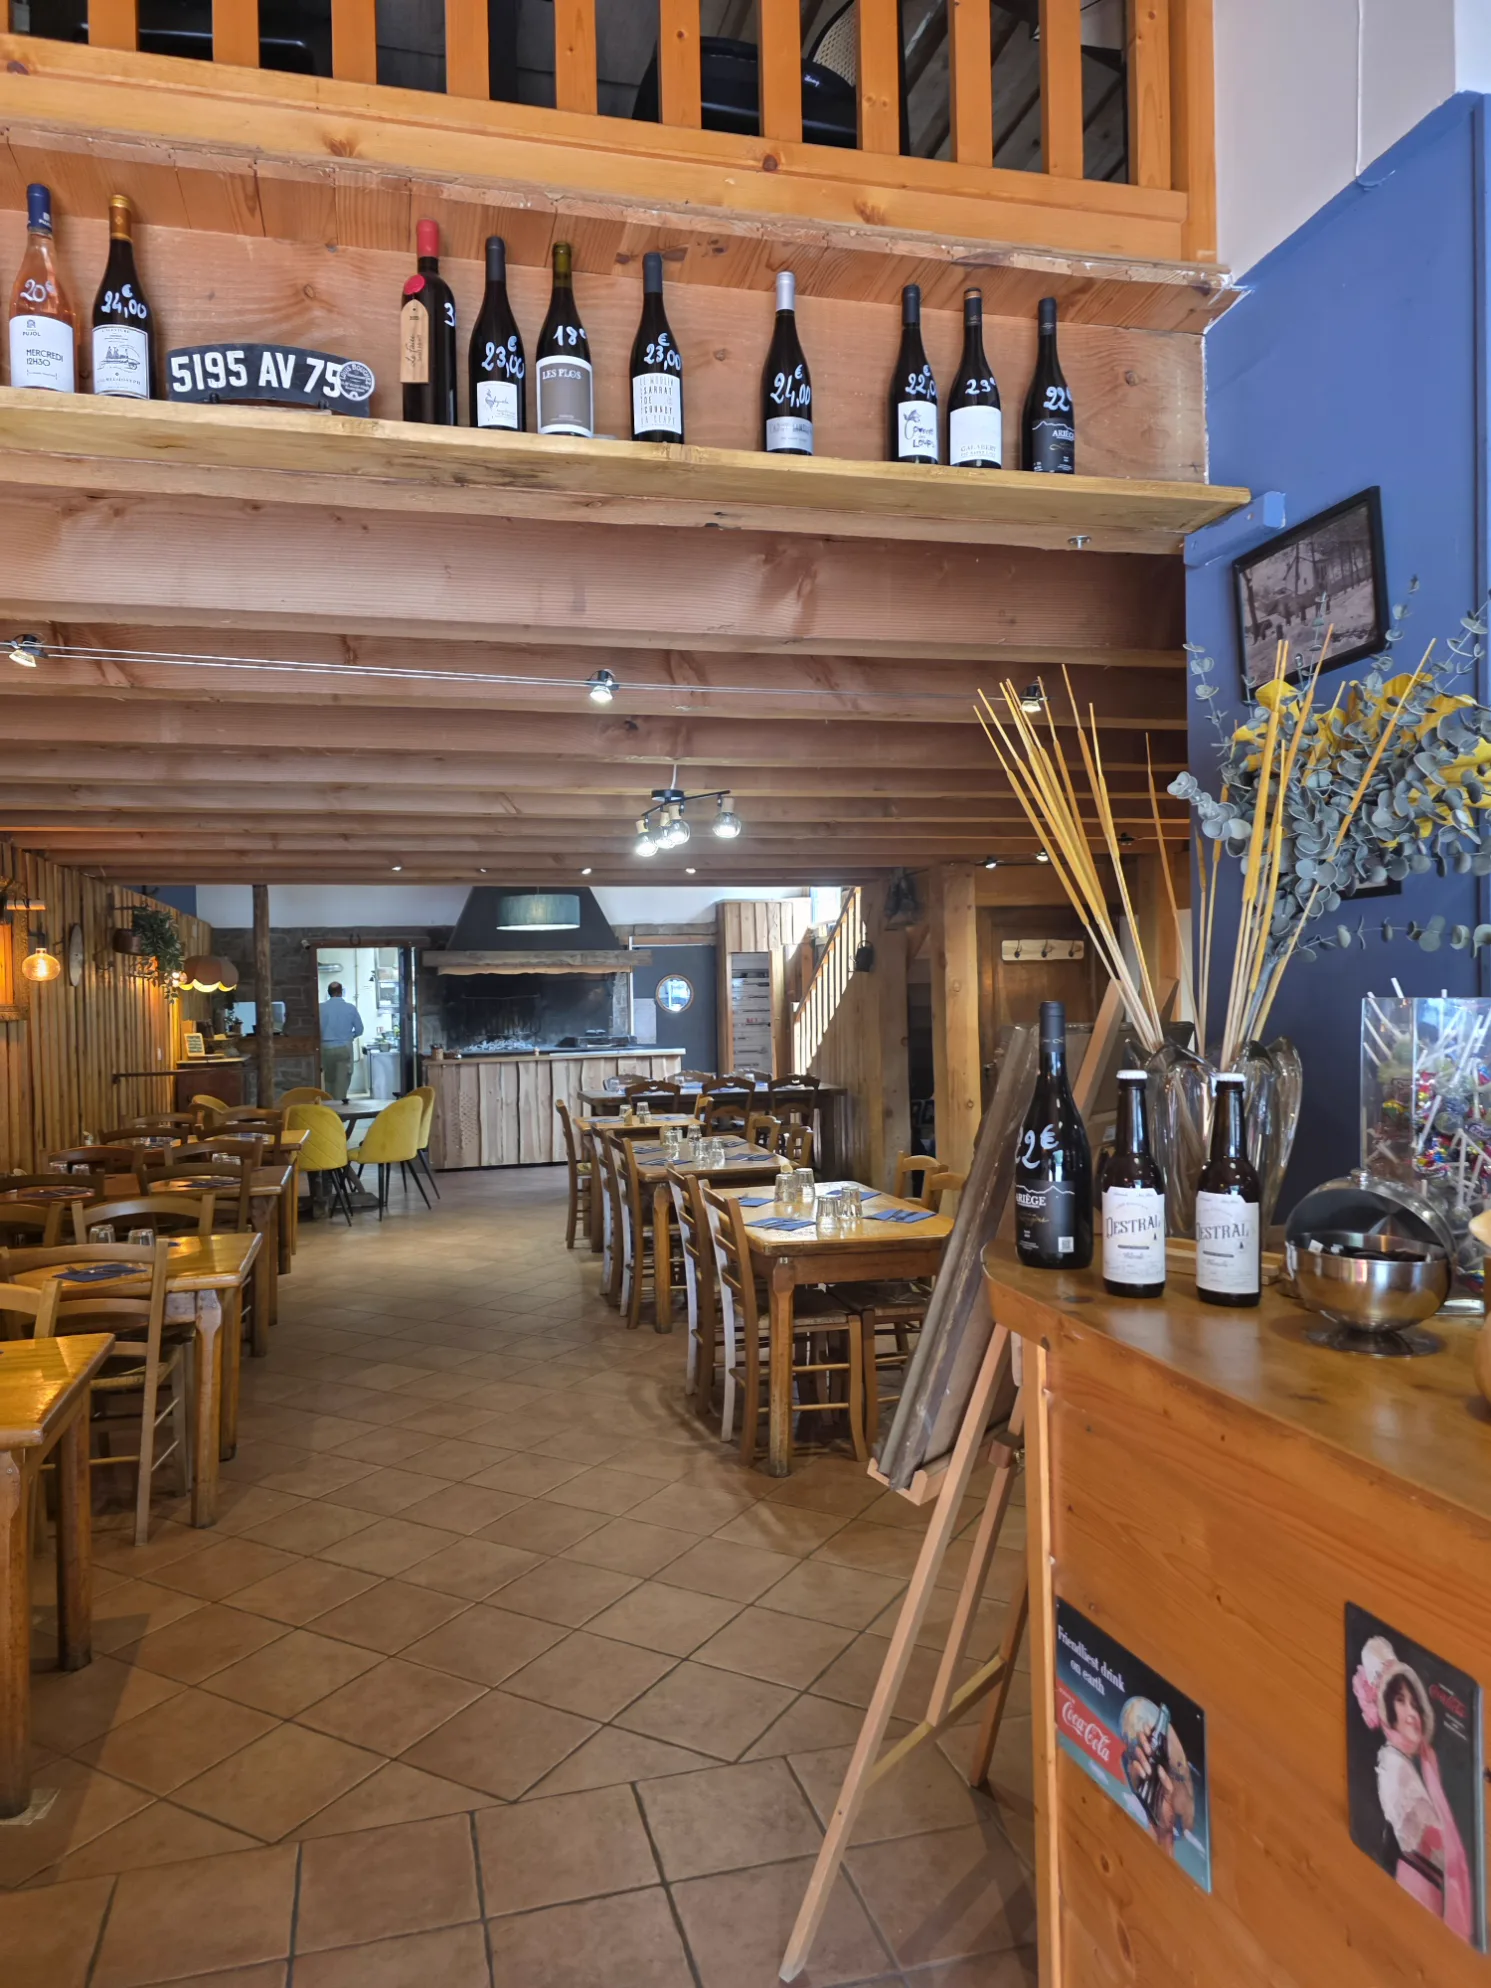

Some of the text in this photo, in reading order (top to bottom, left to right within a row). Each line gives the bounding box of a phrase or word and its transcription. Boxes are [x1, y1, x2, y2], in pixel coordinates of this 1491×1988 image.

[26, 349, 64, 362] MERCREDI
[26, 358, 51, 367] 12H30
[170, 350, 248, 393] 5195
[258, 351, 296, 389] AV
[303, 357, 343, 398] 75
[542, 369, 557, 380] LES
[1058, 1624, 1125, 1693] Friendliest drink
[1070, 1659, 1081, 1676] on
[1082, 1669, 1105, 1696] earth
